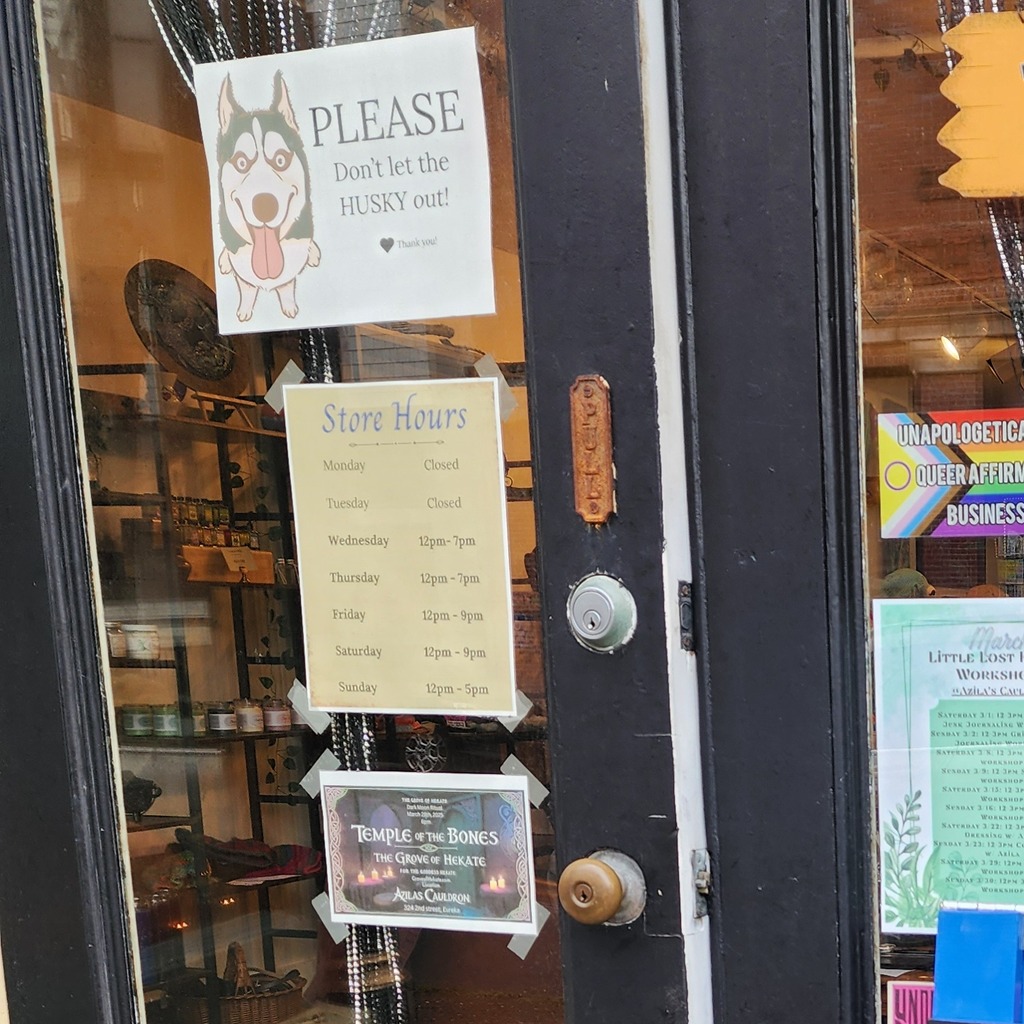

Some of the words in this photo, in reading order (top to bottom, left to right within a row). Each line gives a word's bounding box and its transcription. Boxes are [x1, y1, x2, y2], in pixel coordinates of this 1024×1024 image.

[308, 89, 464, 146] PLEASE
[334, 156, 383, 182] Don't
[388, 155, 414, 177] let
[418, 152, 449, 172] the
[340, 191, 407, 216] HUSKY
[413, 187, 449, 208] out!
[398, 239, 421, 249] Thank
[421, 236, 438, 249] you!
[322, 403, 383, 433] Store
[391, 393, 467, 430] Hours
[323, 459, 365, 473] Monday
[424, 459, 459, 471] Closed
[915, 463, 966, 487] QUEER
[326, 497, 369, 511] Tuesday
[427, 497, 462, 509] Closed
[328, 535, 389, 548] Wednesday
[329, 572, 380, 585] Thursday
[420, 573, 448, 587] 12pm
[457, 573, 480, 587] 7pm
[333, 609, 365, 622] Friday
[422, 610, 450, 623] 12pm
[461, 610, 483, 623] 9pm
[335, 645, 382, 659] Saturday
[424, 647, 451, 660] 12pm
[463, 647, 486, 660] 9pm
[980, 651, 1015, 663] LOST
[338, 681, 377, 695] Sunday
[426, 683, 454, 697] 12pm
[465, 683, 489, 697] 5pm
[351, 824, 412, 846] TEMPLE
[414, 832, 424, 841] OF
[425, 831, 444, 842] THE
[447, 827, 499, 846] BONES
[373, 852, 393, 863] THE
[395, 851, 429, 866] GROVE
[430, 855, 440, 864] OF
[443, 854, 487, 867] HEKATE
[392, 886, 424, 903] AZILAS
[424, 888, 471, 905] CAULDRON
